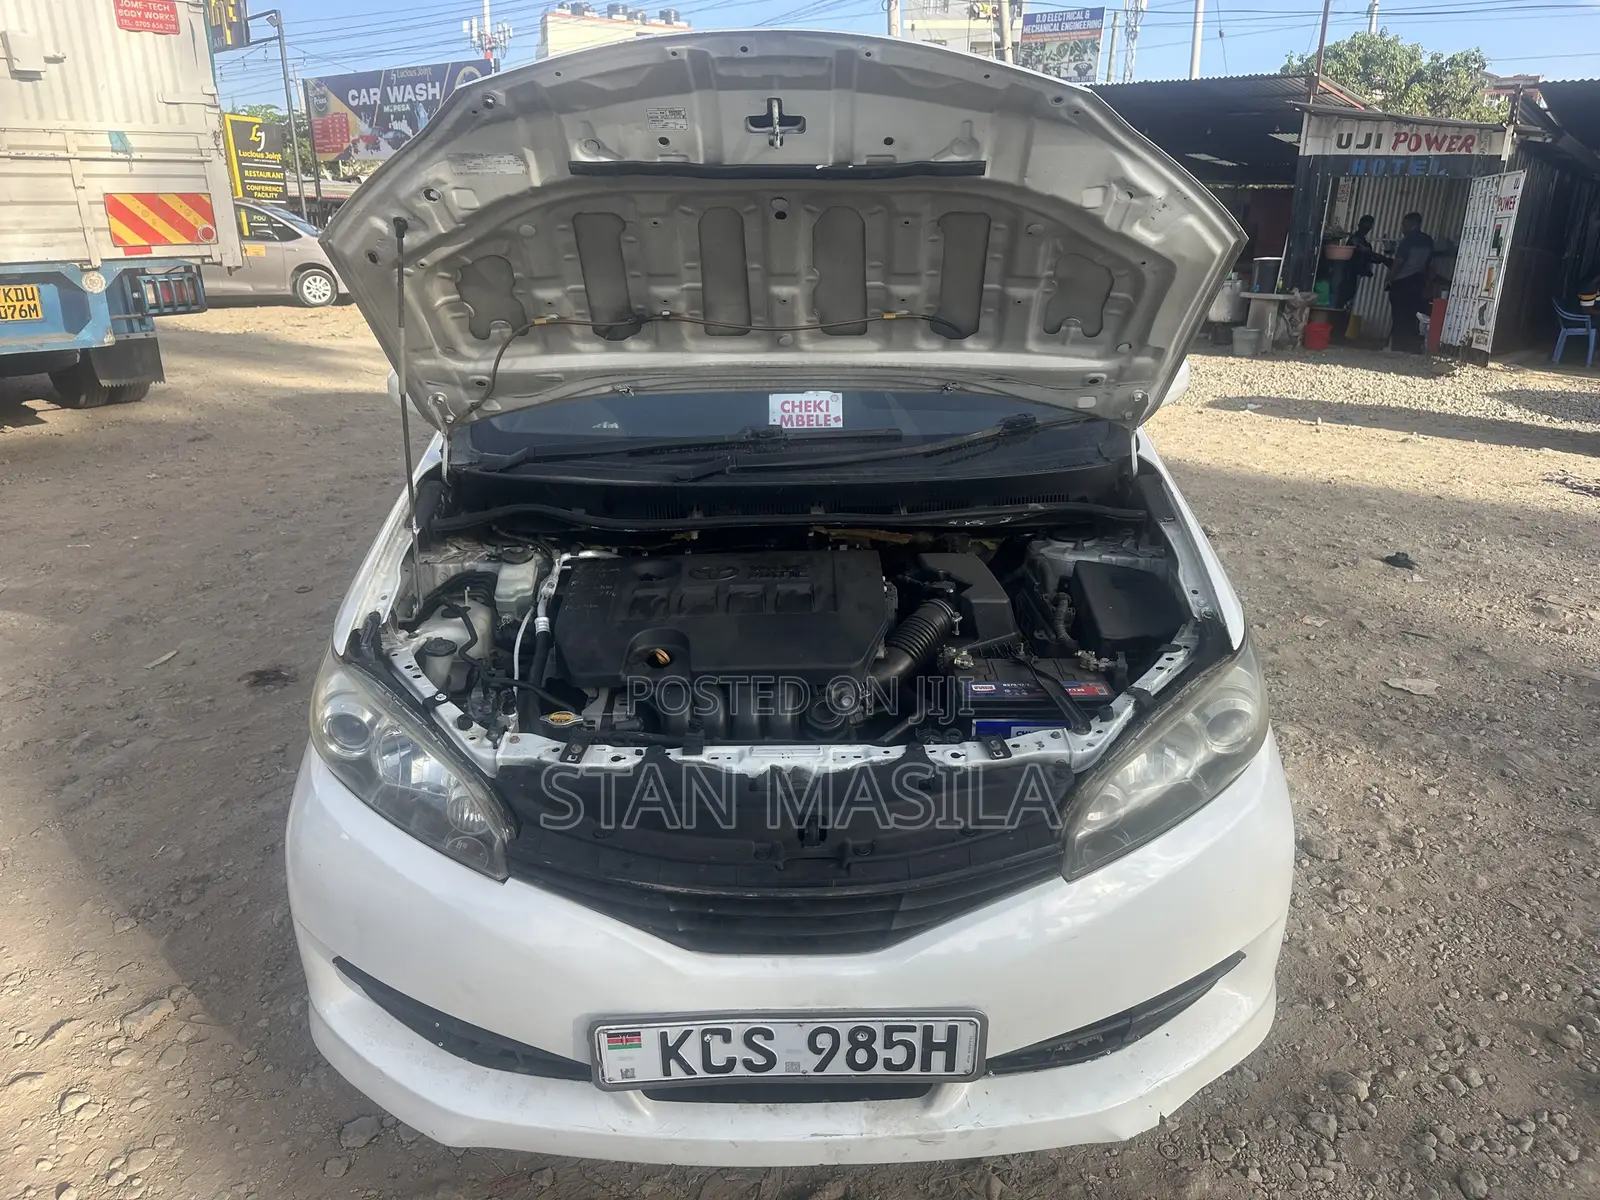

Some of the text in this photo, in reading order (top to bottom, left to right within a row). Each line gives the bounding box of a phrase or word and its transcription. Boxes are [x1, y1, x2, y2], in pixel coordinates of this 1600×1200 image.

[118, 9, 176, 21] BODY WORKS
[1047, 11, 1084, 22] ELECTRICAL
[1084, 10, 1090, 19] &
[1023, 19, 1102, 34] MECHANICAL ENGINEERING
[348, 87, 381, 107] CAR
[386, 82, 441, 103] WASH
[1336, 133, 1383, 149] UJI
[1391, 132, 1476, 153] POWER
[238, 149, 282, 163] Lucious Joint
[1351, 158, 1446, 176] HOTEL
[244, 170, 284, 179] RESTAURANT
[246, 184, 283, 192] CONFERENCE
[3, 287, 36, 302] KDU
[780, 400, 830, 413] CHEKI
[780, 414, 831, 427] MBELE
[658, 1026, 779, 1077] KCS
[806, 1023, 959, 1073] 985H
